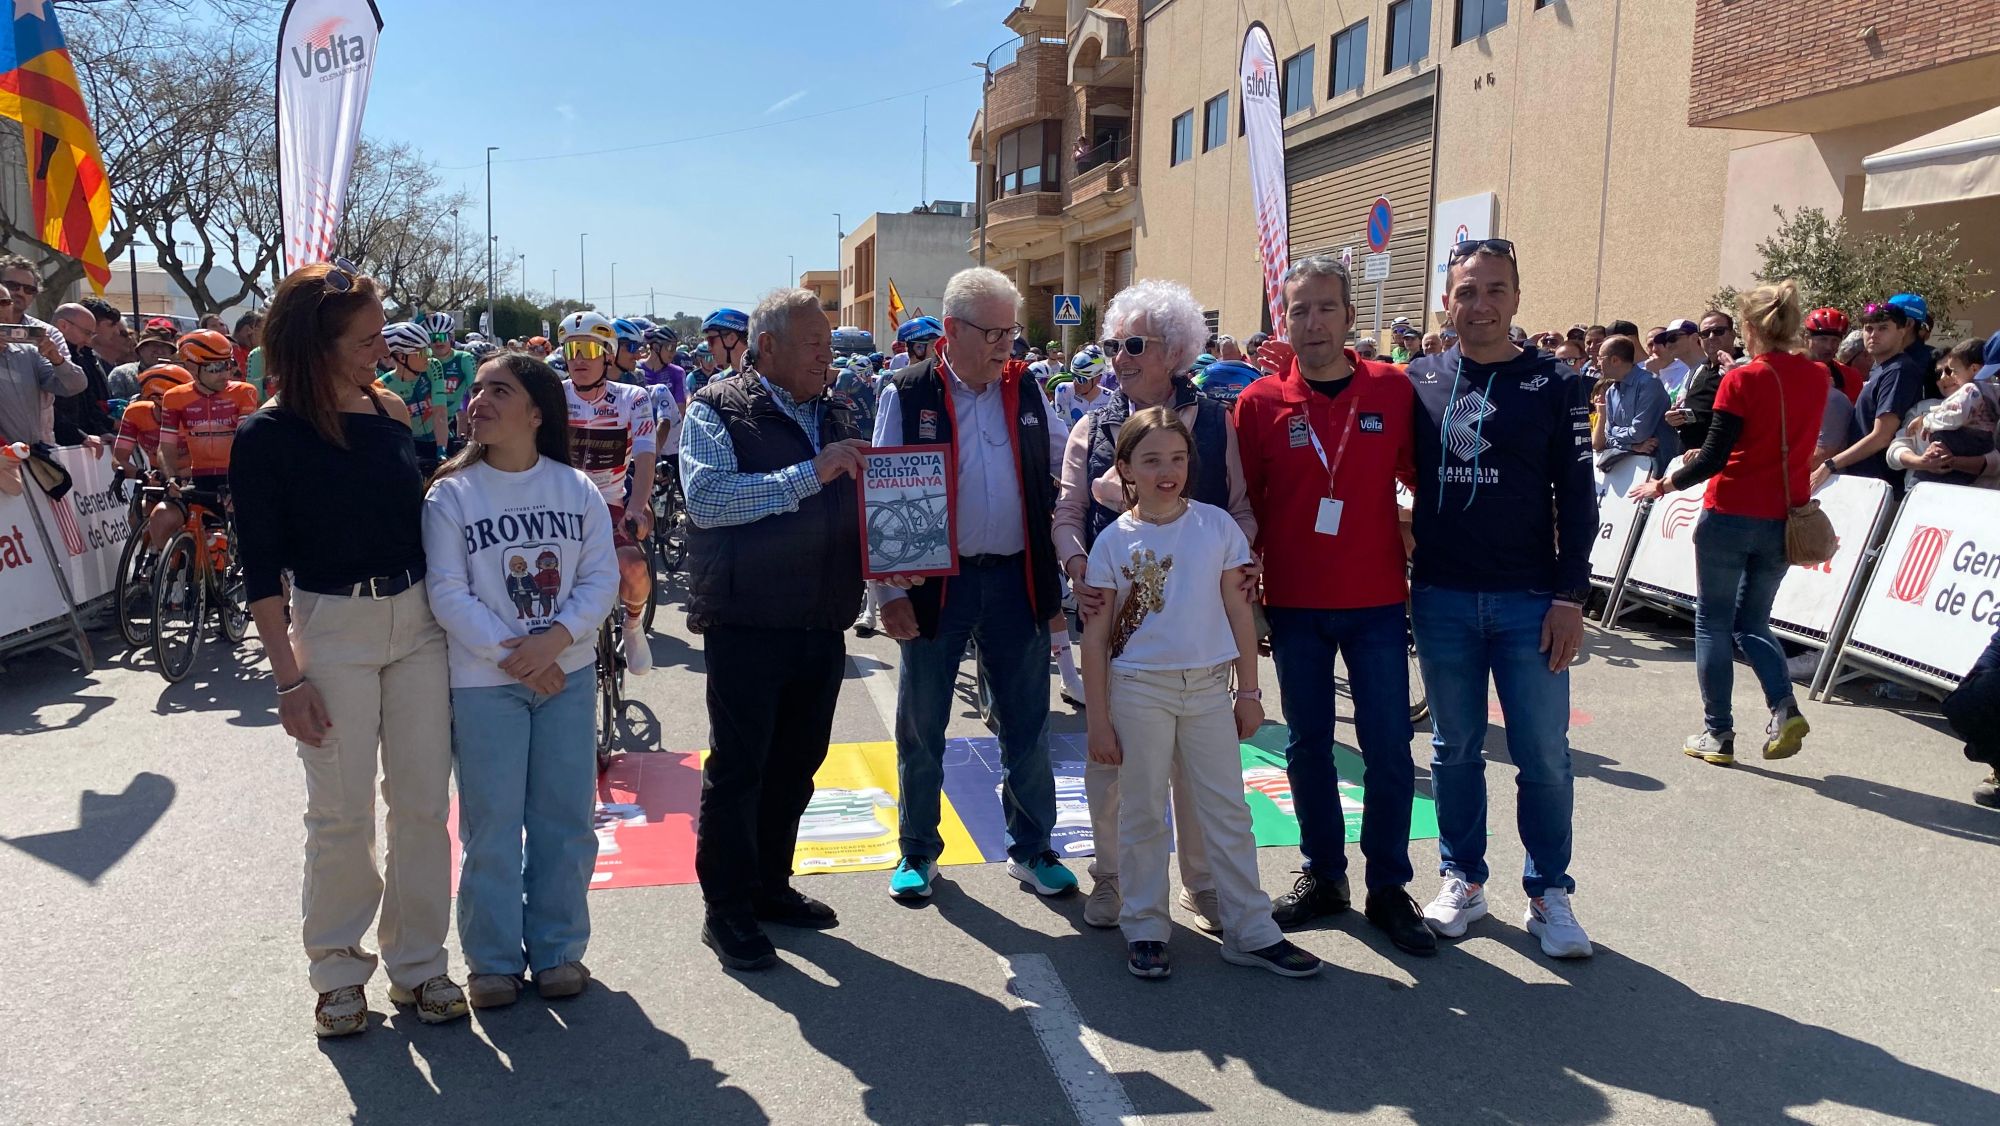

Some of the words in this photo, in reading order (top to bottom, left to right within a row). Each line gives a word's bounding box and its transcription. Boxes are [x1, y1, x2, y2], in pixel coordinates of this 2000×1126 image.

[291, 34, 365, 78] Volta
[593, 407, 615, 416] Volta
[1020, 416, 1039, 426] Volta
[1360, 419, 1383, 430] Volta
[868, 457, 892, 468] 105
[899, 454, 942, 467] VOLTA
[866, 466, 920, 479] CICLISTA
[932, 465, 943, 476] A
[1438, 466, 1499, 477] BAHRAIN
[867, 476, 943, 490] CATALUNYA
[88, 525, 105, 550] de
[1935, 582, 1967, 616] de
